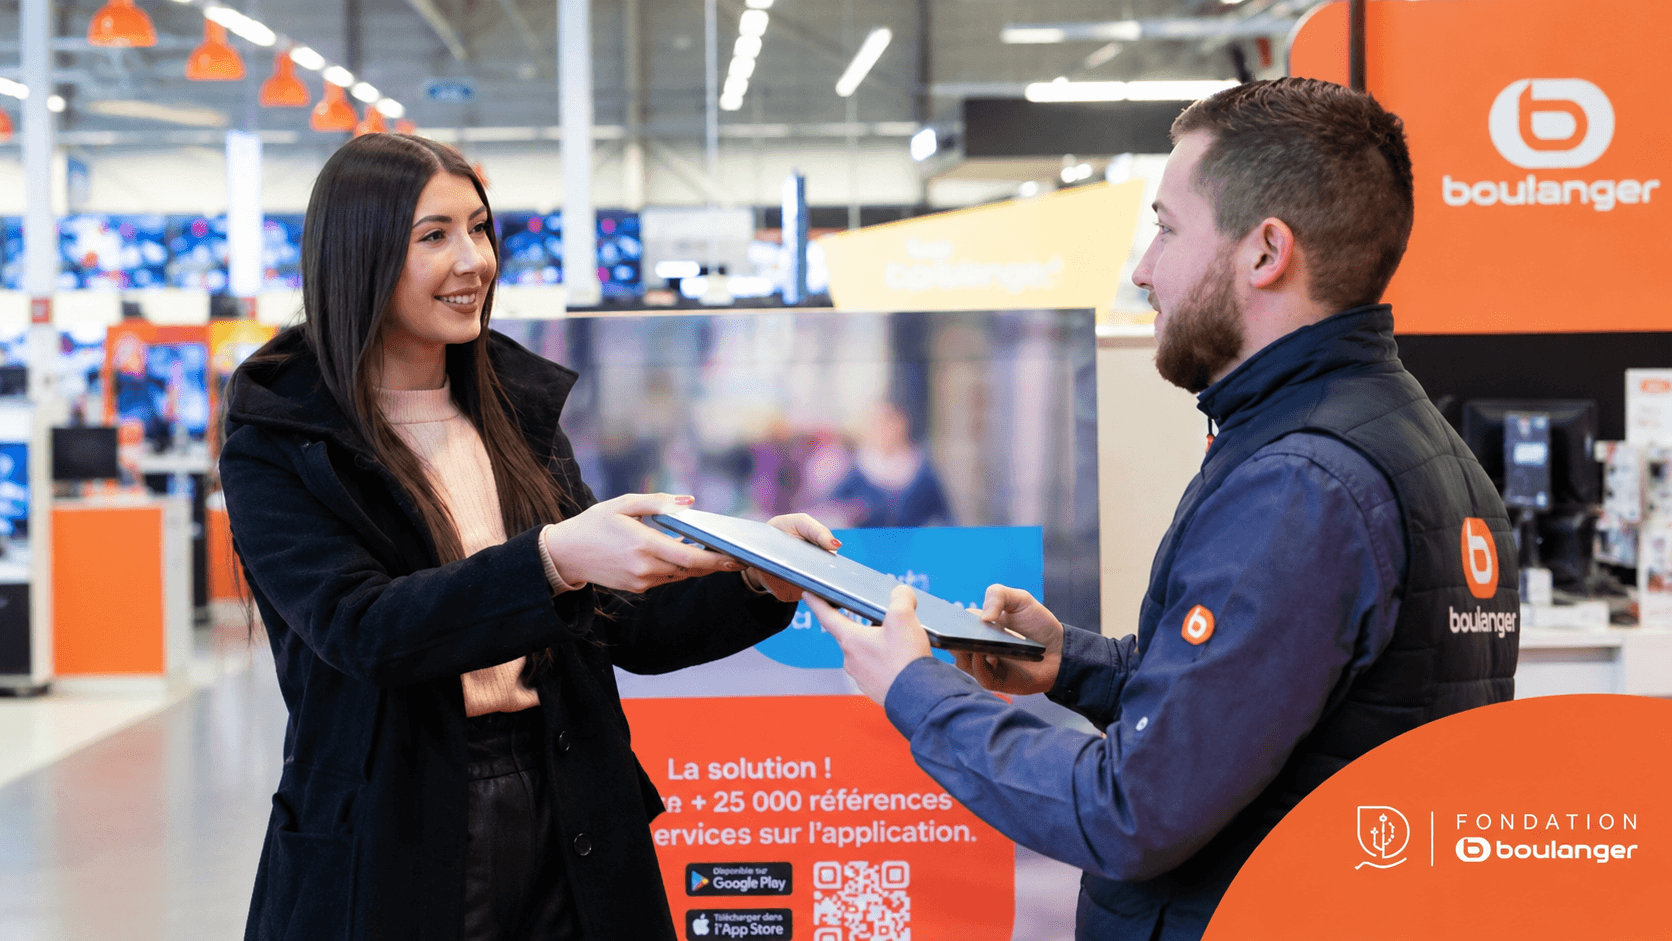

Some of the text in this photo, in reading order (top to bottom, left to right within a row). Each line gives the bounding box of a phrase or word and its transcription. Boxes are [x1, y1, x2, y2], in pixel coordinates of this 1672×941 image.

[1442, 174, 1661, 212] boulanger
[1449, 605, 1518, 639] boulanger
[668, 755, 832, 781] La solution !
[713, 790, 746, 813] 25
[752, 790, 803, 813] 000
[809, 787, 953, 812] références
[653, 819, 978, 849] ervices sur l'application.
[712, 875, 787, 893] Google Play
[750, 922, 784, 936] Store
